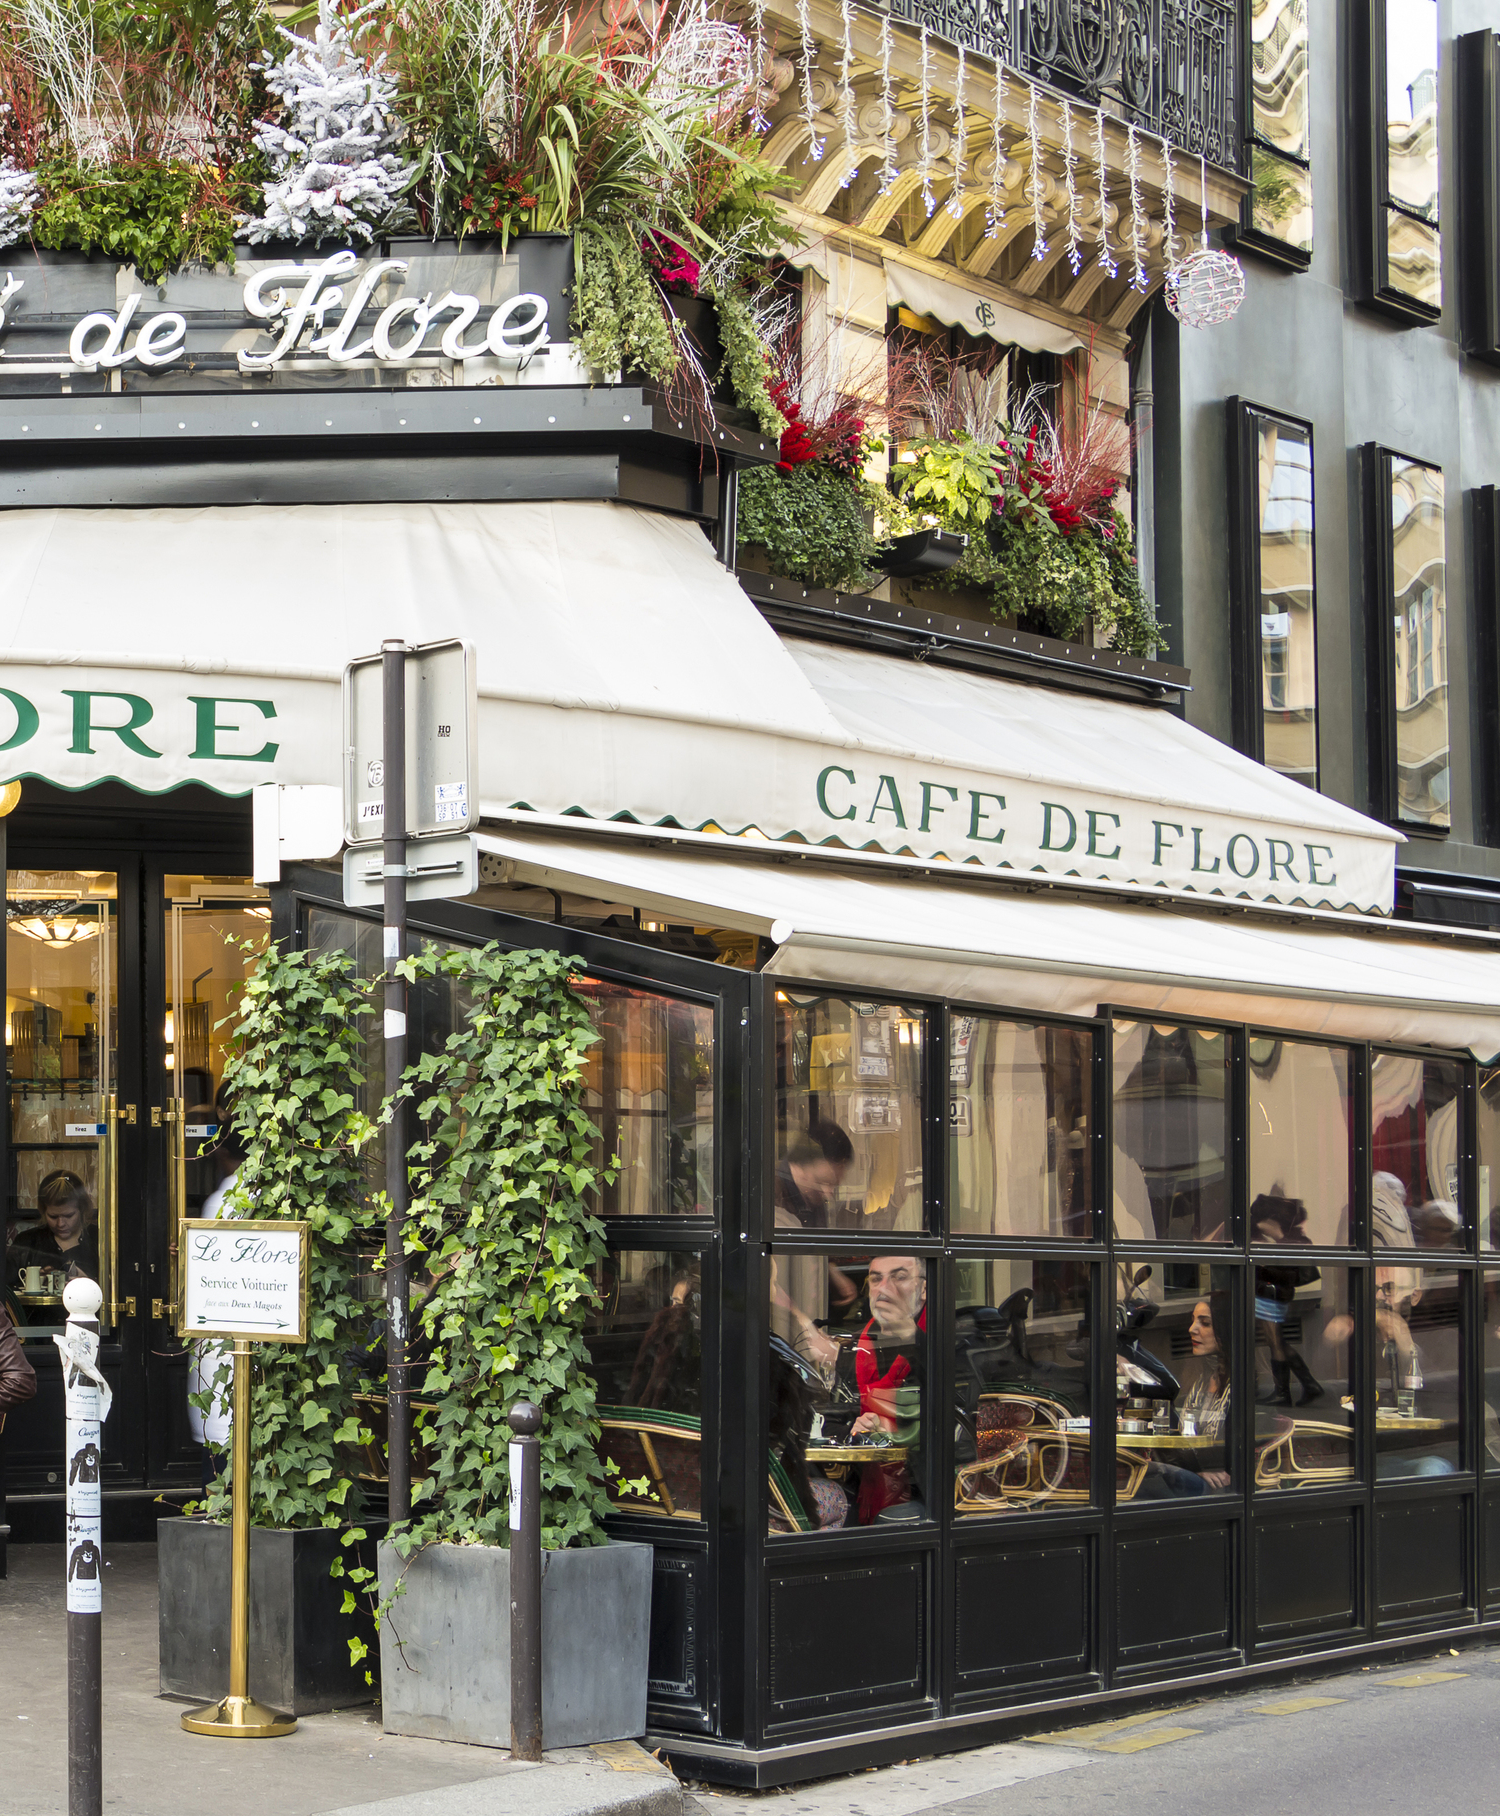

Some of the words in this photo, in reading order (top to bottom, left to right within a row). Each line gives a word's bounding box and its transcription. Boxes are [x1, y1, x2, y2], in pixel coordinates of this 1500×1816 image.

[70, 293, 187, 367] de
[237, 250, 551, 373] Flore
[815, 765, 1007, 844] CAFE
[1039, 801, 1122, 860] DE
[1151, 820, 1337, 887] FLORE
[192, 1234, 221, 1262] Le
[230, 1237, 298, 1265] Flore
[200, 1276, 238, 1289] Service
[241, 1277, 288, 1292] Voiturier
[203, 1298, 217, 1309] face
[231, 1299, 251, 1308] Deux
[253, 1300, 282, 1312] Magots
